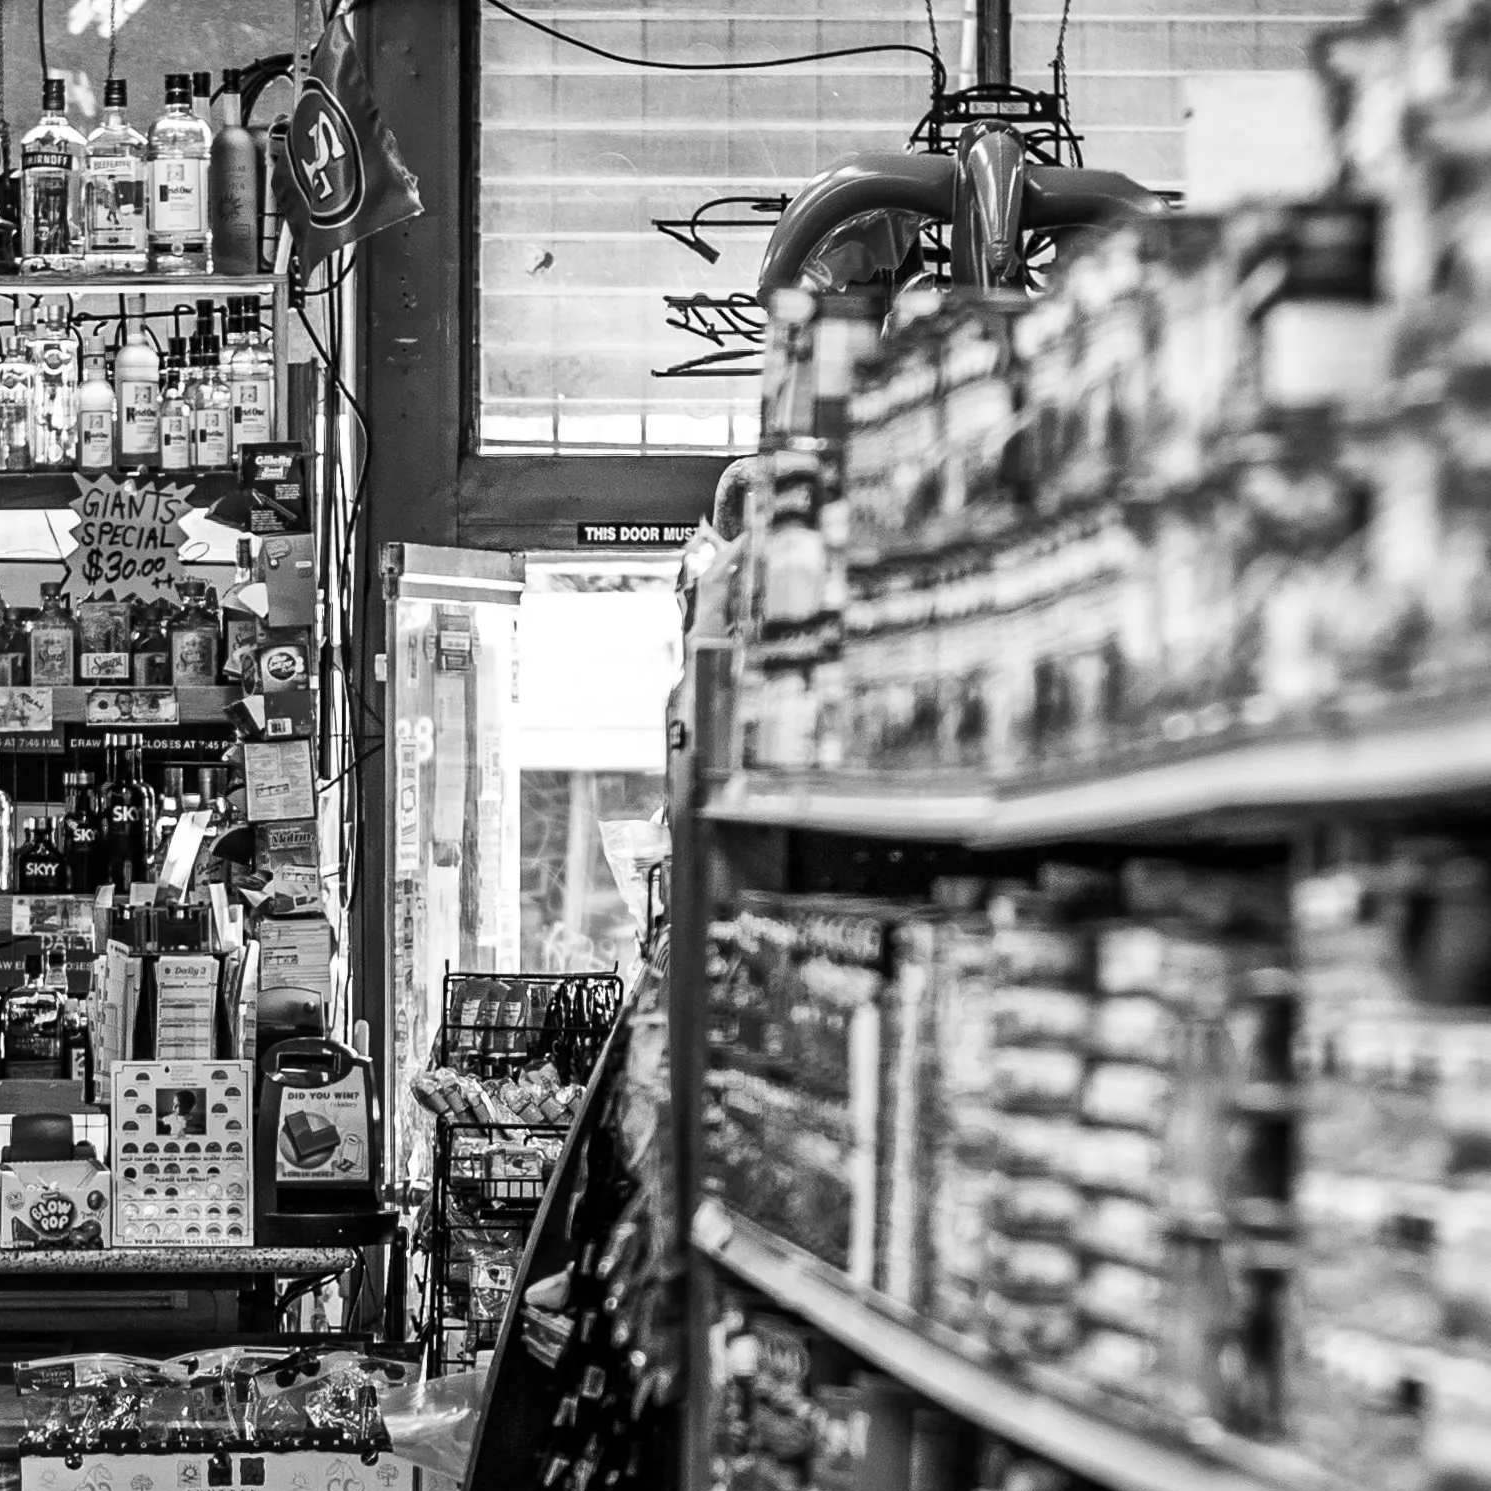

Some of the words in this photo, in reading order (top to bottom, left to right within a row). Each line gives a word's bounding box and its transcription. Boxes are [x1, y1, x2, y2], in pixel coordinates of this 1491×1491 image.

[255, 454, 293, 467] Gillette
[82, 487, 182, 525] GIANTS
[81, 521, 176, 550] SPECIAL
[584, 526, 618, 541] THIS
[620, 527, 659, 541] DOOR
[82, 547, 167, 585] $30.00
[70, 738, 102, 748] DRAW
[141, 739, 181, 749] CLOSES
[183, 740, 196, 749] AT
[25, 862, 59, 876] SKYY
[174, 966, 199, 977] Daily
[200, 967, 207, 975] 3
[287, 1092, 306, 1100] DID
[309, 1092, 331, 1100] YOU
[333, 1091, 360, 1100] WIN?
[30, 1200, 72, 1219] BLOW
[41, 1215, 70, 1231] POP
[45, 1440, 226, 1449] CALIFORNIA
[253, 1438, 377, 1450] CHERRIE
